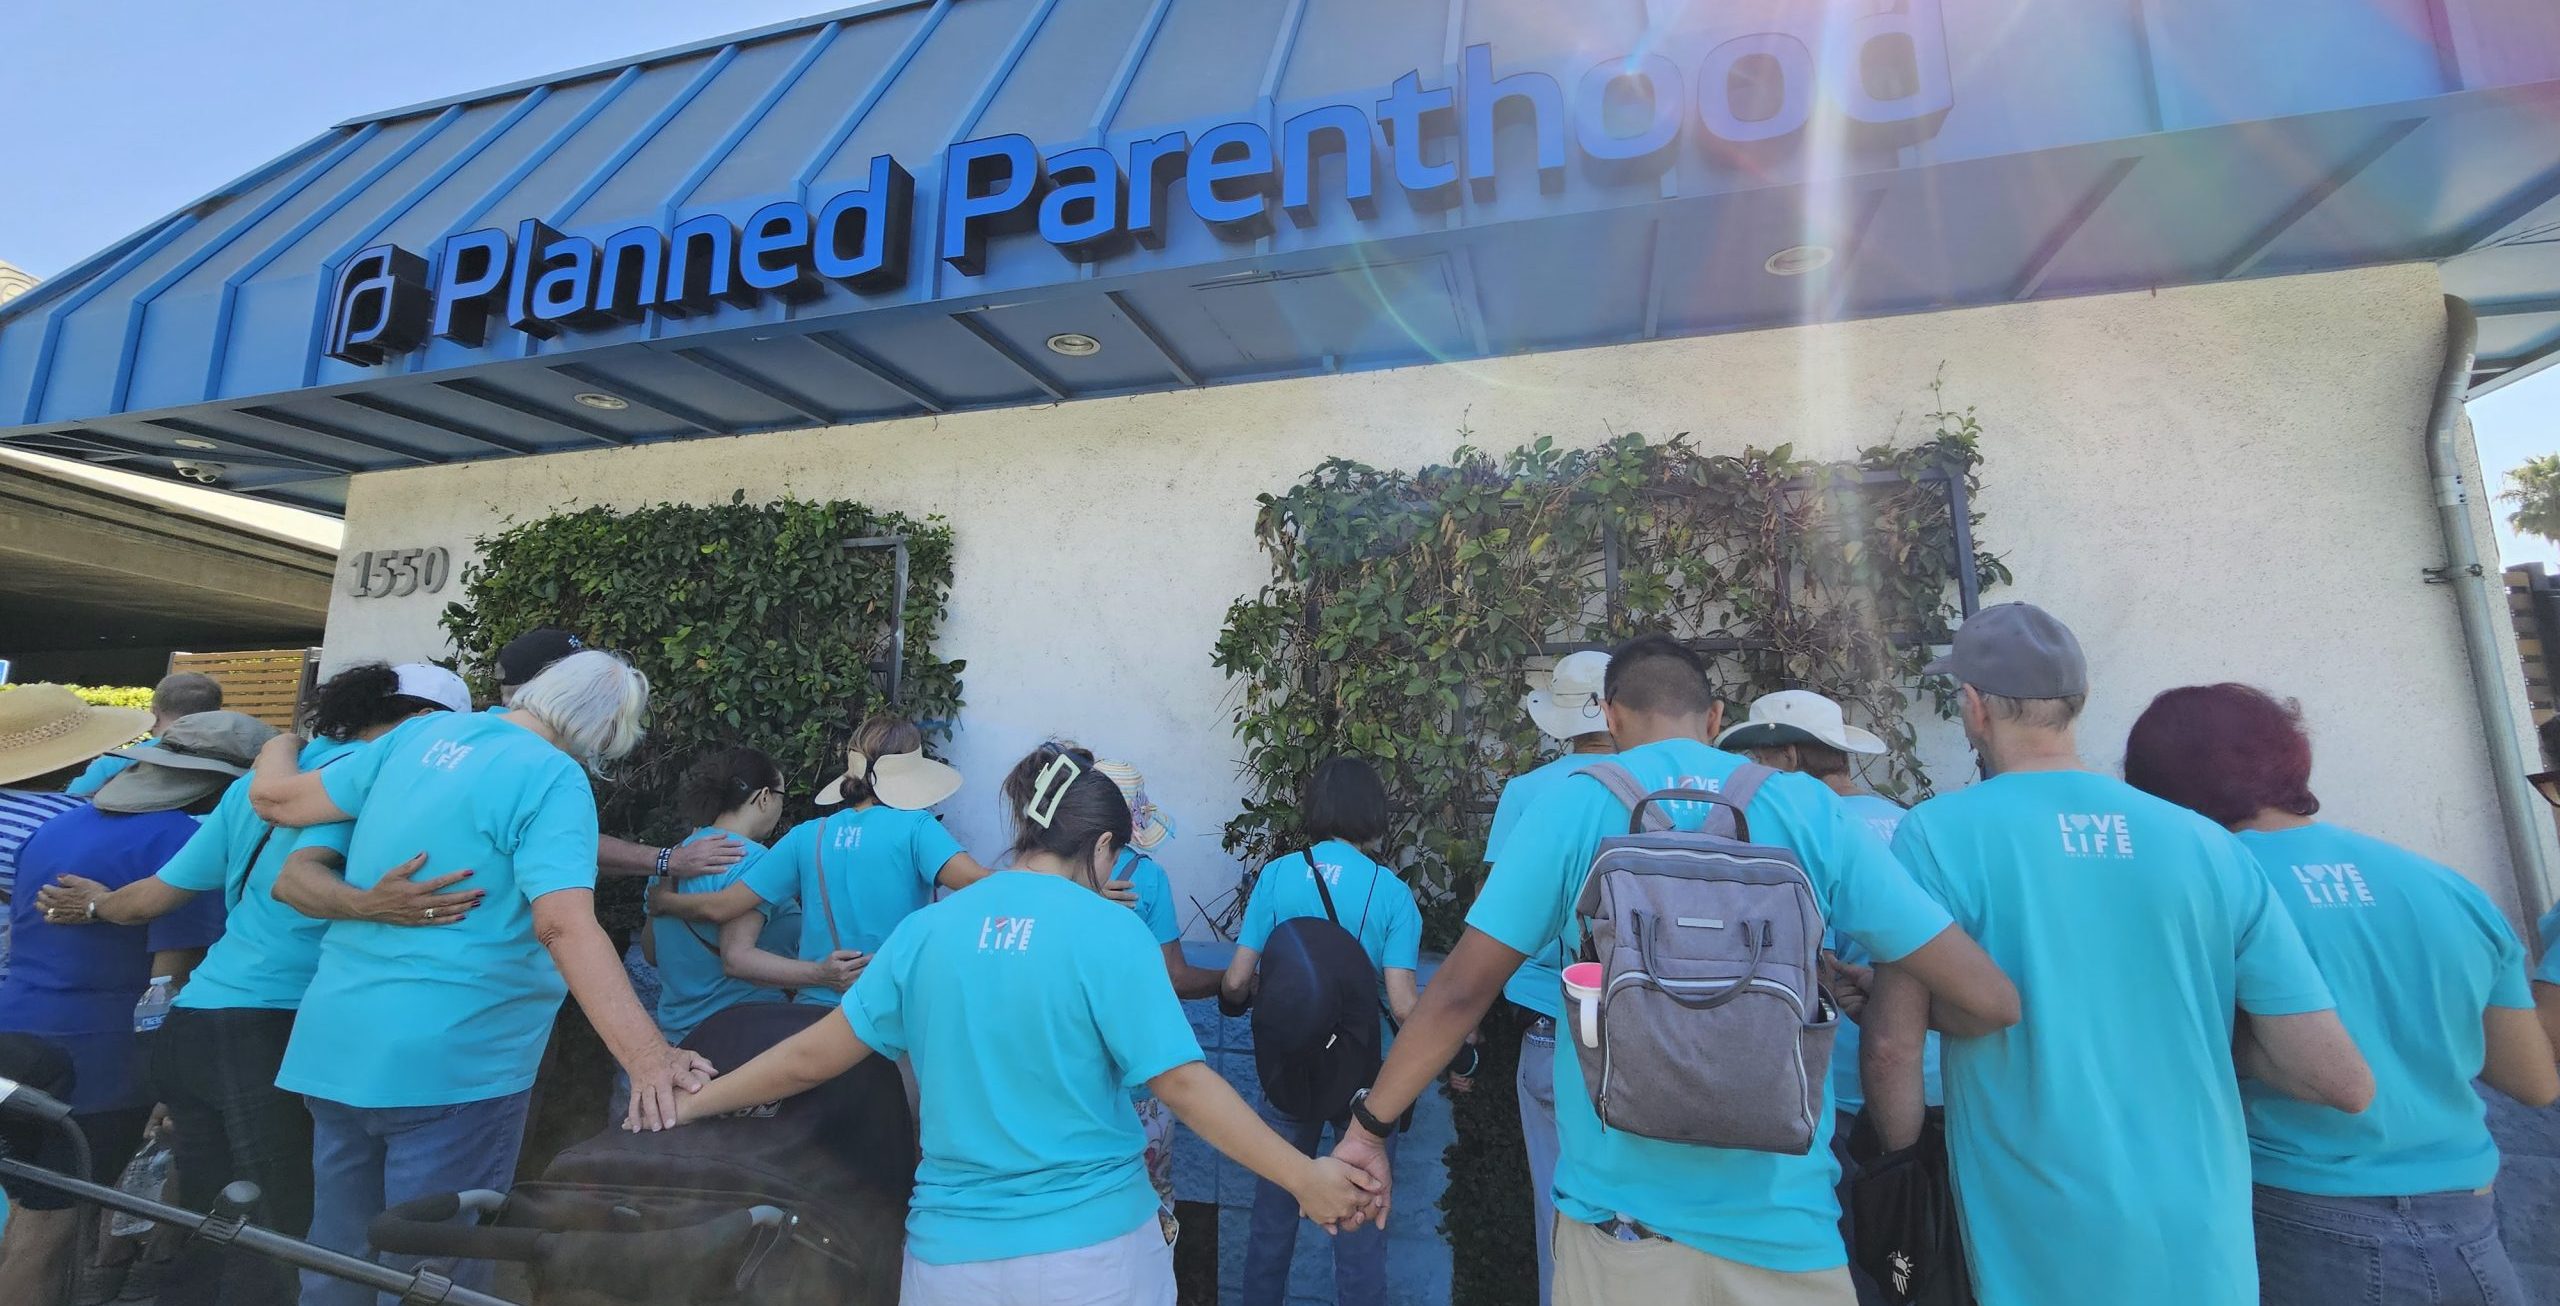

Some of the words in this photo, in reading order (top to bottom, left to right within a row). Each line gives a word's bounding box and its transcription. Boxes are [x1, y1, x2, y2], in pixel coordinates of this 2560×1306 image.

[433, 154, 900, 342] Planned
[943, 0, 1954, 260] Parenthood
[347, 546, 450, 598] 1550
[2062, 833, 2133, 853] LIFE
[2302, 882, 2375, 903] LIFE
[979, 931, 1031, 951] LIFE
